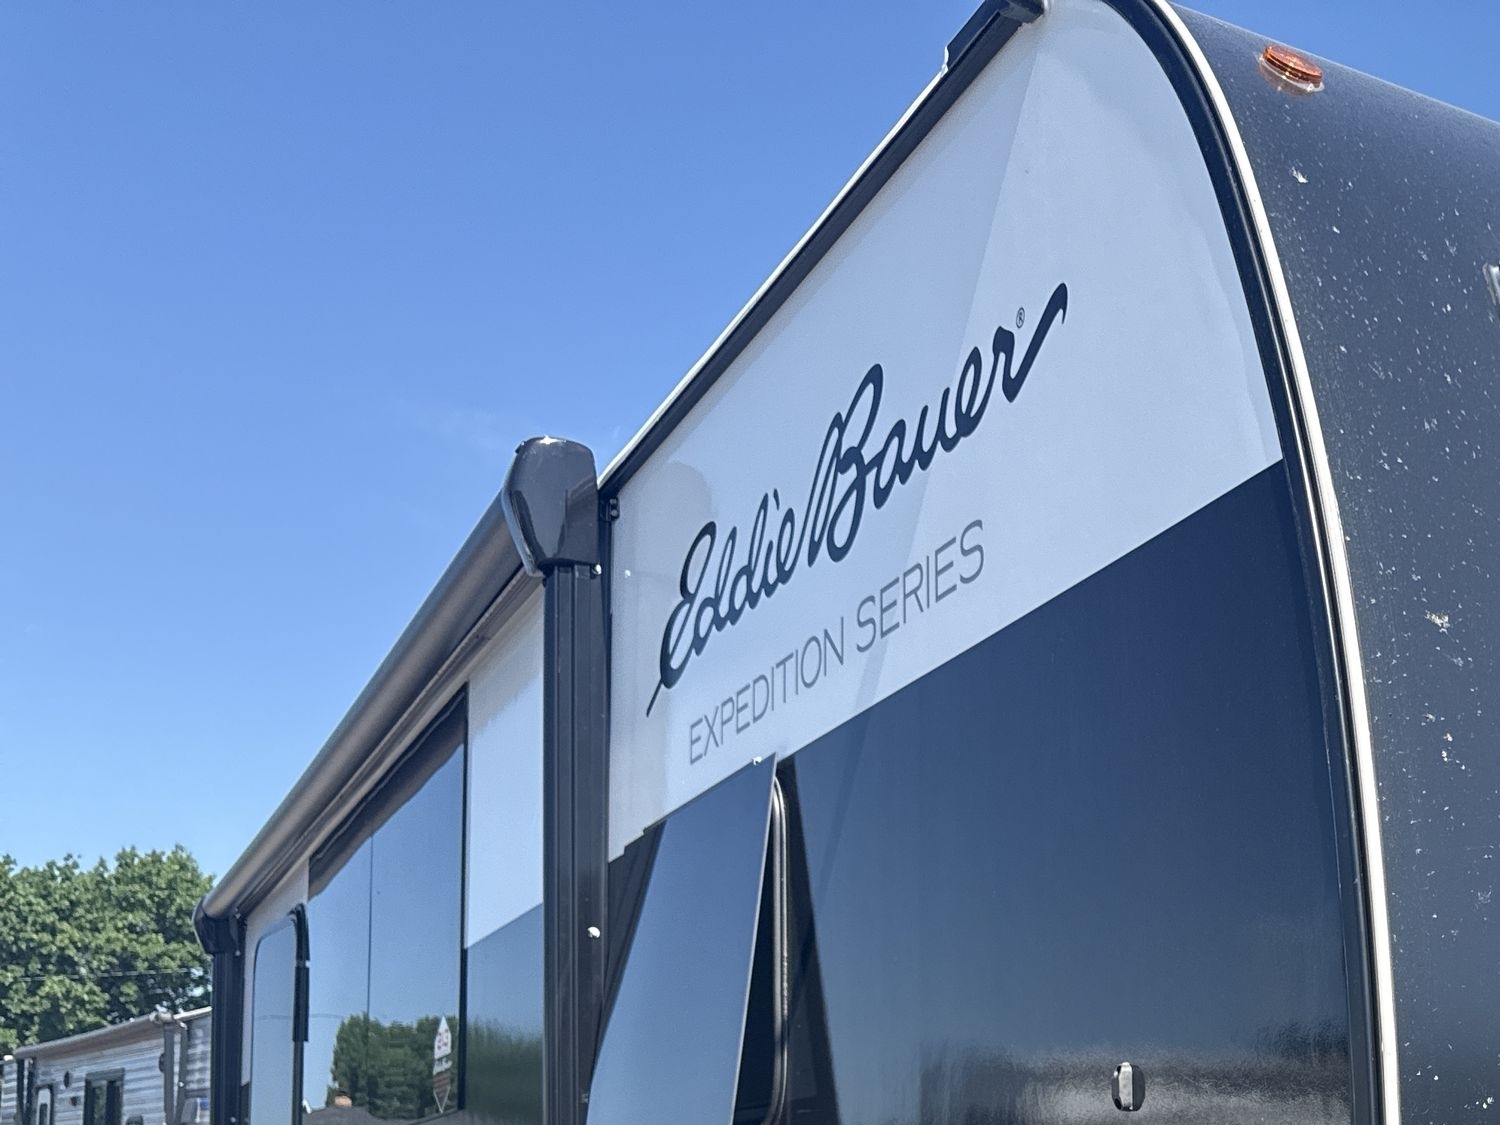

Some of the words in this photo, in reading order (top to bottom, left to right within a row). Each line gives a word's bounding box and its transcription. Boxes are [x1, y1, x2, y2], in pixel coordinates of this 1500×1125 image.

[646, 486, 806, 718] Eddie
[688, 615, 846, 766] EXPEDITION
[856, 518, 986, 654] SERIES
